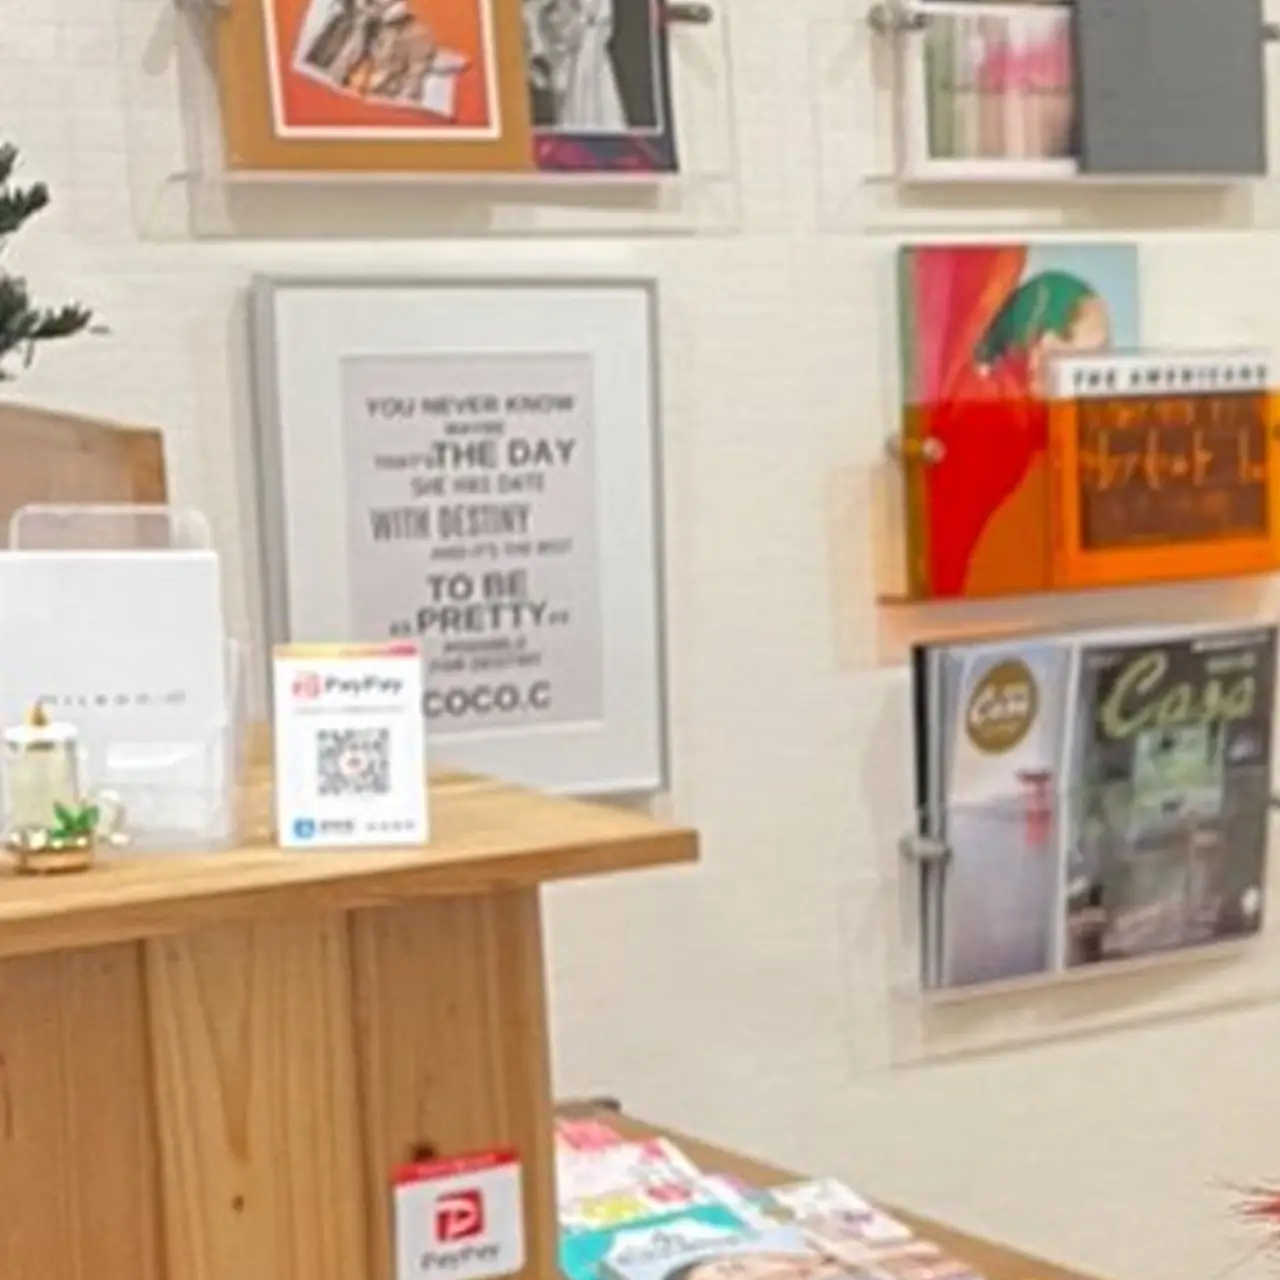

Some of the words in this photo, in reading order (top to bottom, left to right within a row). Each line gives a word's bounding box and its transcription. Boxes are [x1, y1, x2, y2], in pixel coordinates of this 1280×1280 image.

[1072, 368, 1117, 388] THE
[1129, 363, 1268, 387] AMERICANS
[366, 397, 415, 418] YOU
[421, 395, 498, 415] NEVER
[505, 394, 575, 412] KNOW
[432, 439, 497, 468] THE
[508, 437, 576, 467] DAY
[426, 572, 474, 601] TO
[482, 568, 528, 598] BE
[416, 599, 547, 634] PRETTY
